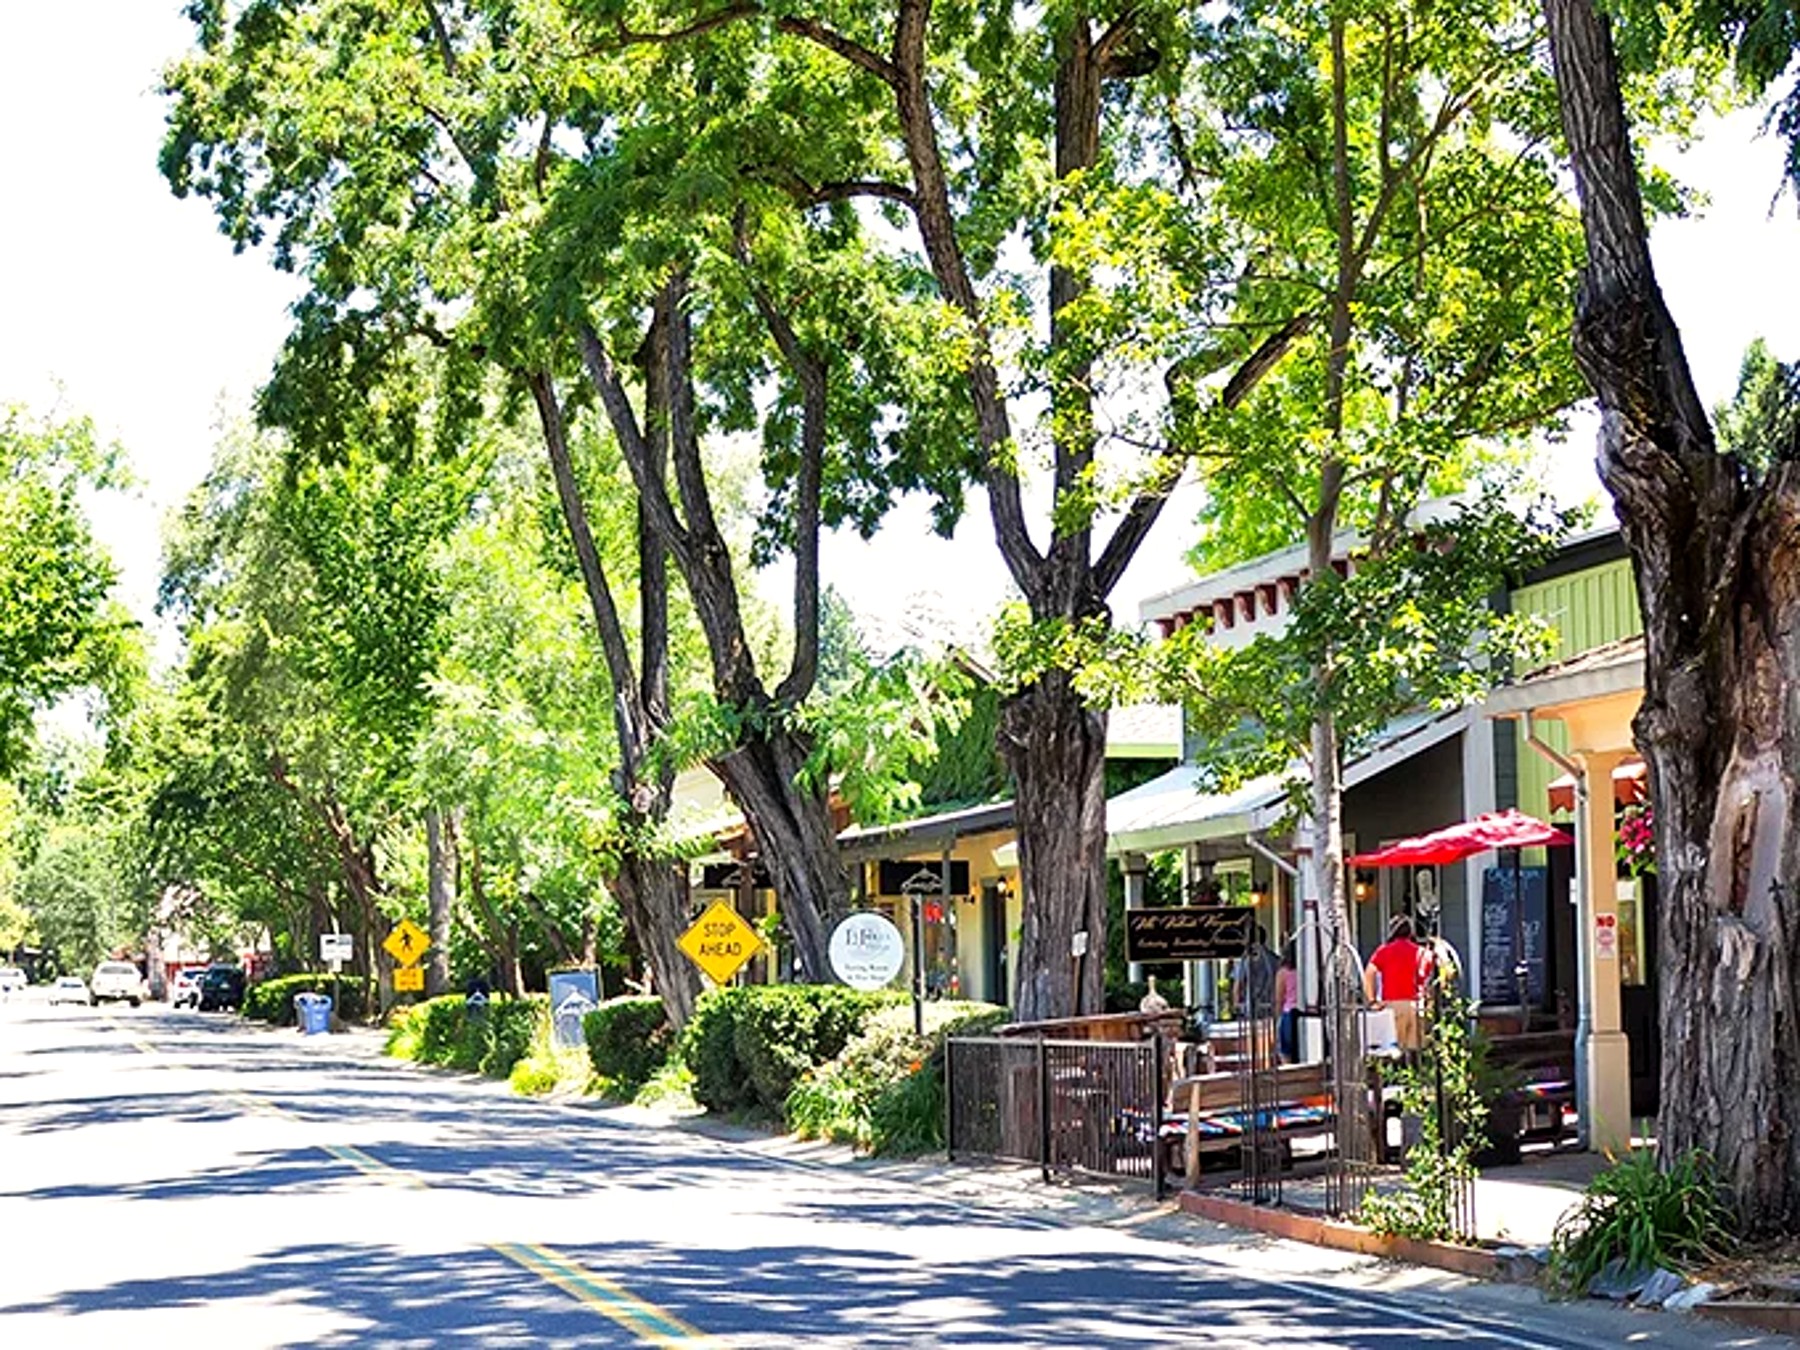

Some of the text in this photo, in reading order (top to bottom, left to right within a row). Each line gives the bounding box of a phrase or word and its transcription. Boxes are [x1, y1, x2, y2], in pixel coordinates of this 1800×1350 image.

[1596, 914, 1615, 928] NO
[703, 922, 737, 938] STOP
[698, 941, 742, 957] AHEAD
